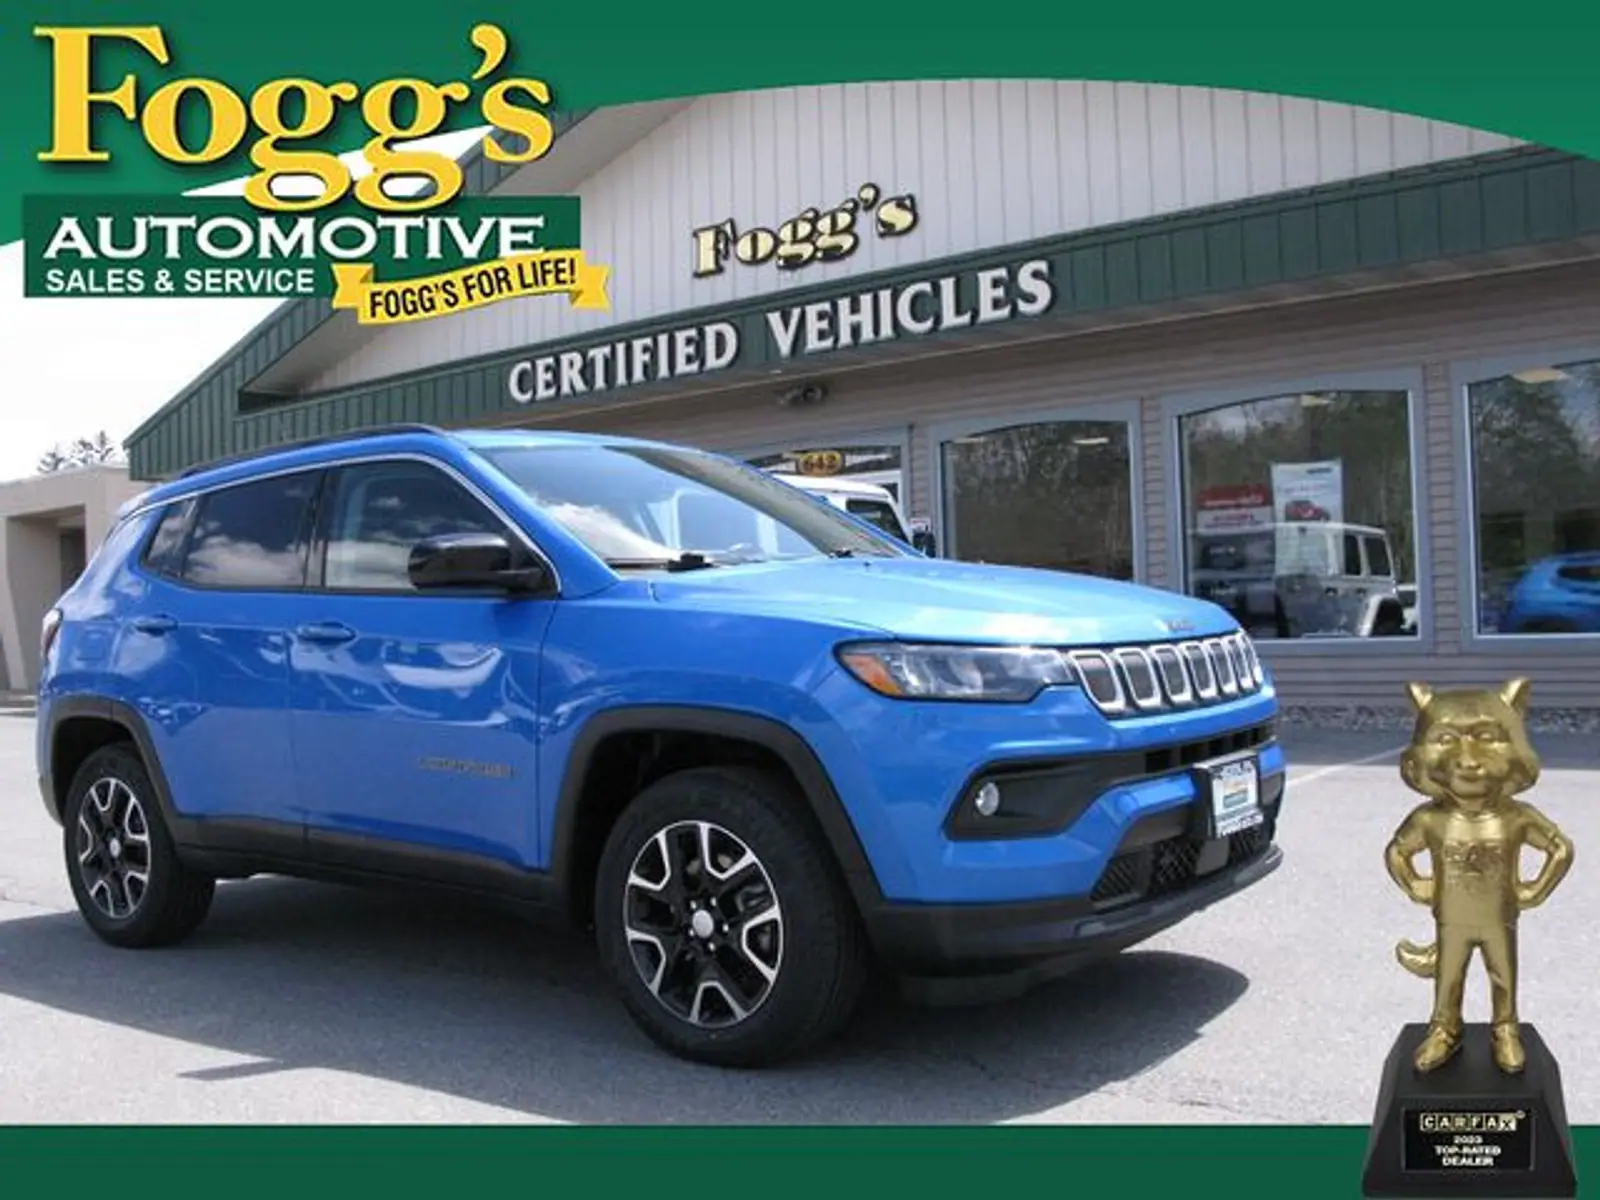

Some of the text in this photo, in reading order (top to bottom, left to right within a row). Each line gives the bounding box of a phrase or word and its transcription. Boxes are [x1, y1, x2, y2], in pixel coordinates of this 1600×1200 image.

[693, 182, 920, 277] Fogg's
[508, 258, 1054, 403] CERTIFIED VEHICLES
